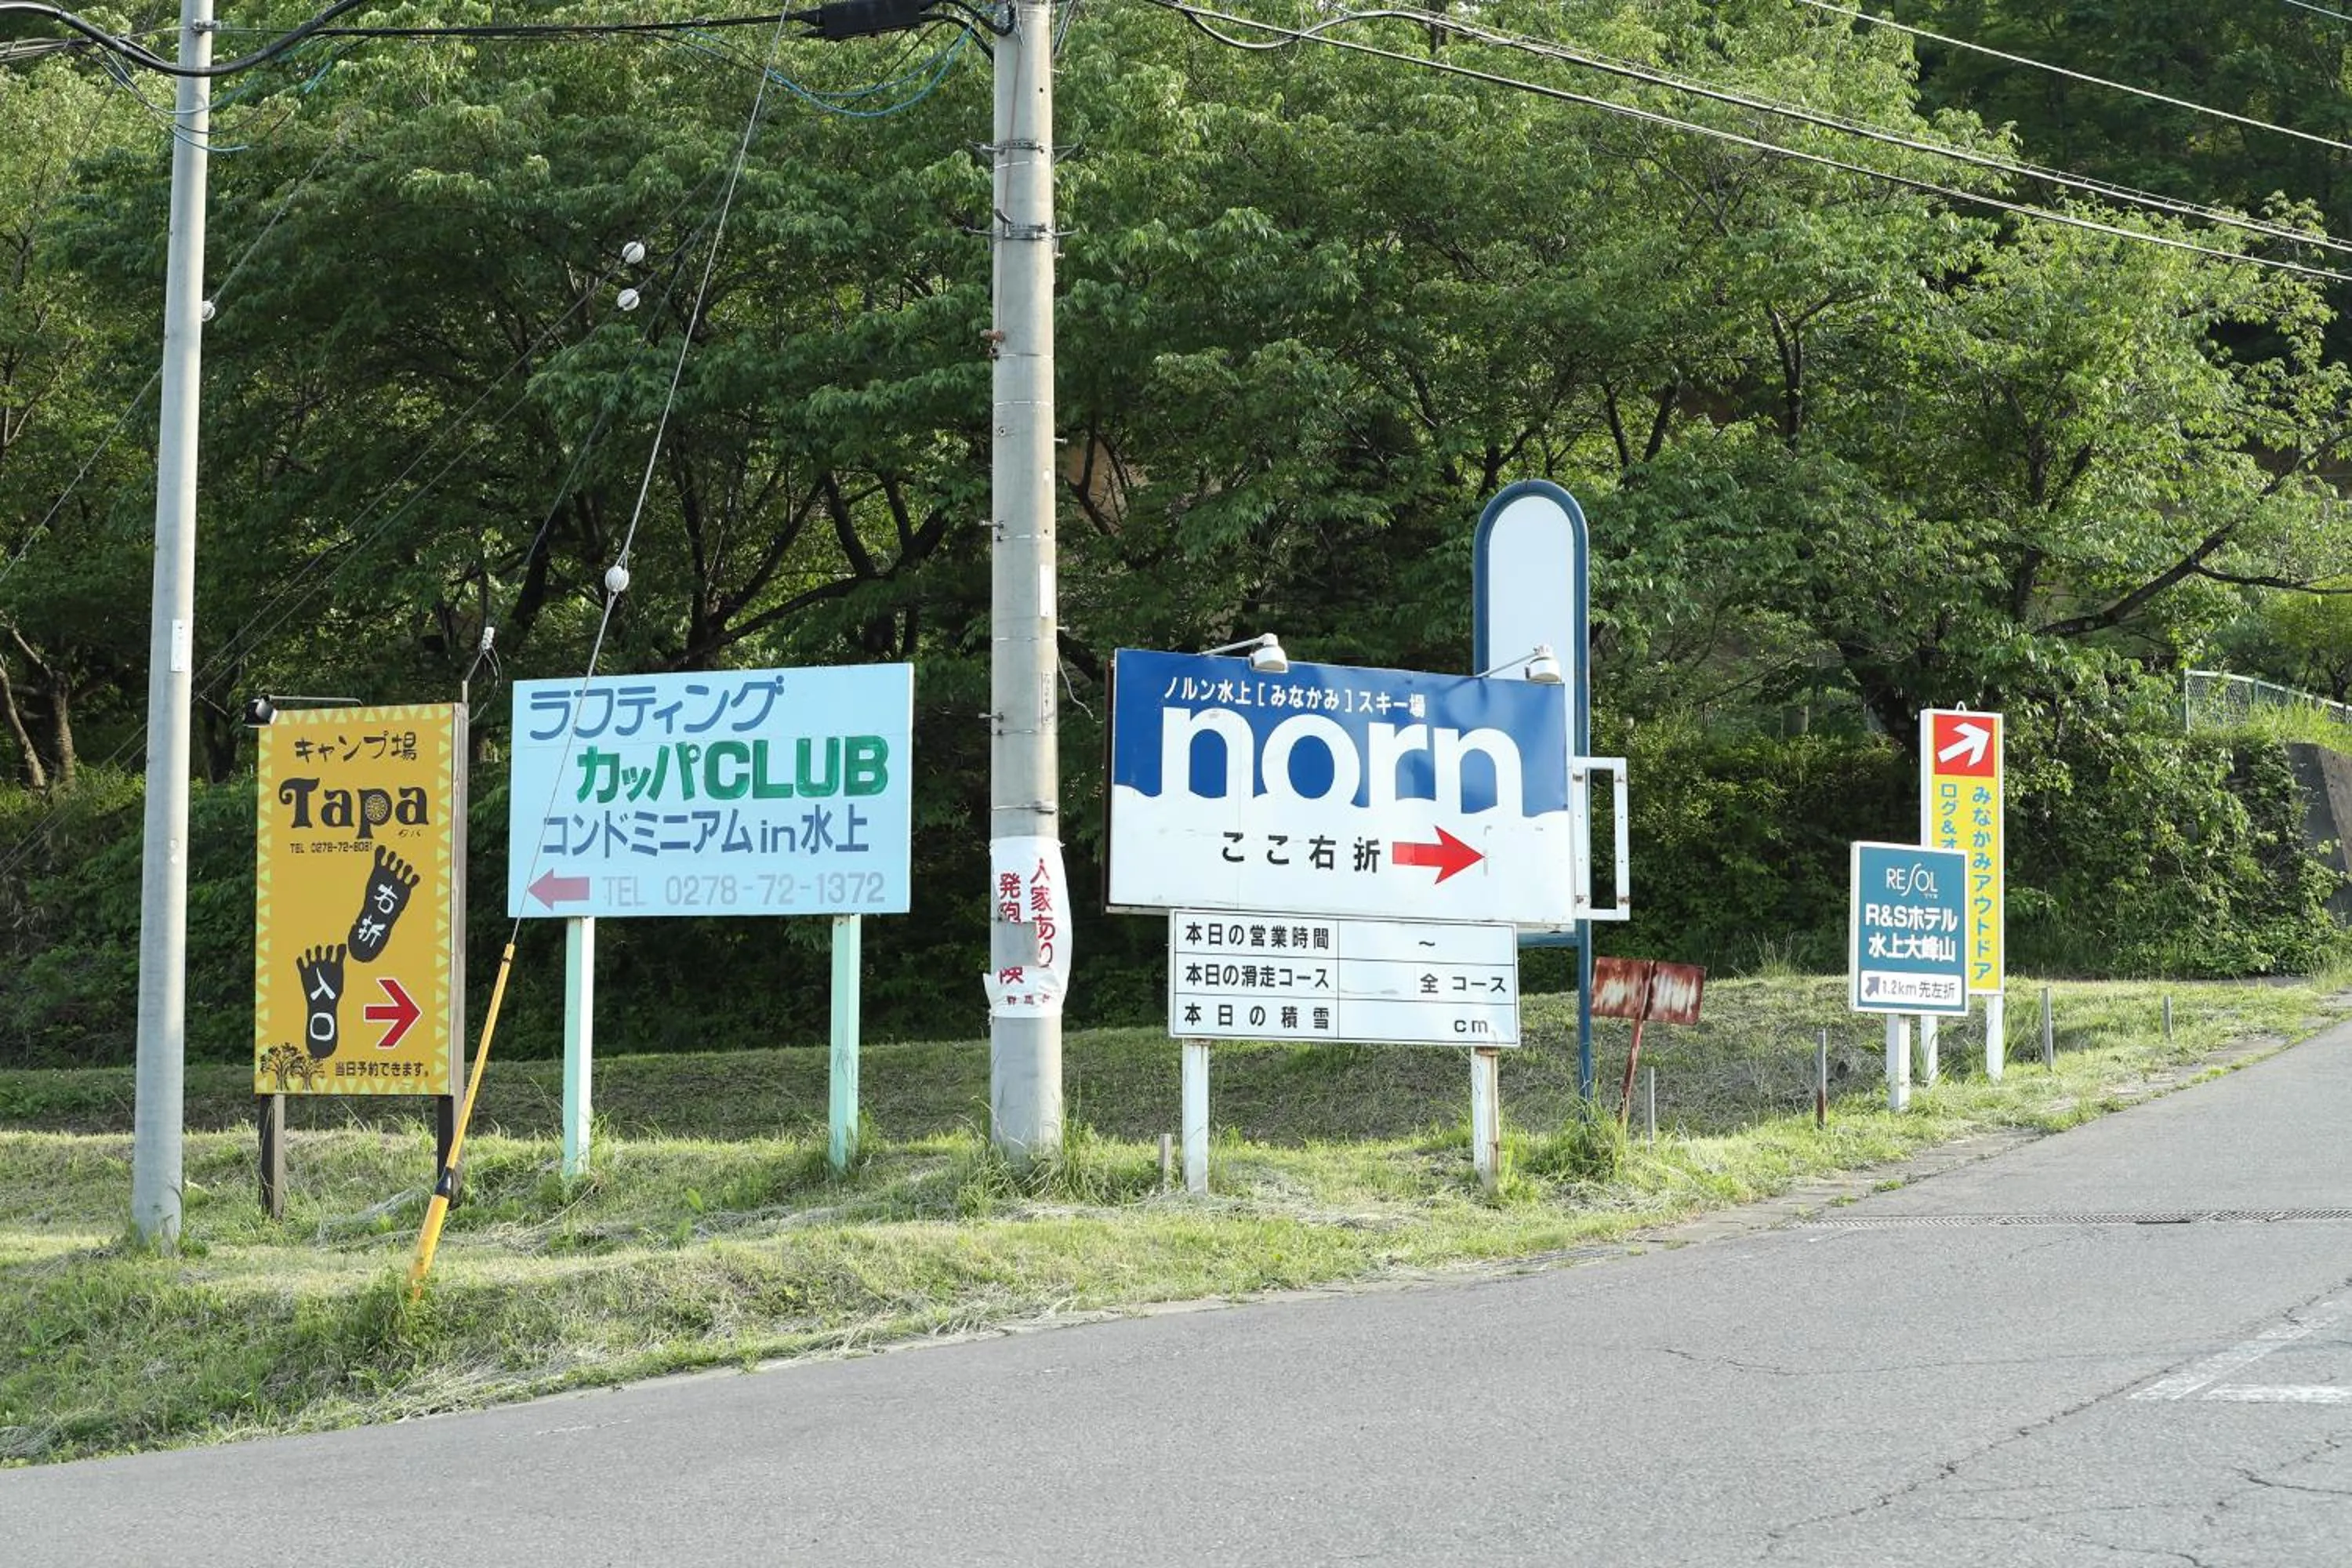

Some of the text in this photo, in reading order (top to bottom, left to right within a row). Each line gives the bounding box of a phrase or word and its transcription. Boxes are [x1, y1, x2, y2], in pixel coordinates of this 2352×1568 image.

[529, 675, 784, 740] ラフティング
[294, 731, 417, 762] キャンプ場
[1162, 706, 1523, 817] norn
[577, 735, 889, 803] カッパCLUB
[278, 777, 429, 840] Tapa
[290, 843, 304, 853] TEL
[542, 804, 870, 858] コンドミニアムin水上
[1221, 831, 1381, 874] ここ右折
[602, 872, 886, 906] TEL 0278-72-1372
[1886, 862, 1938, 897] RESOL
[1973, 786, 1992, 980] みなかみアウトドア
[358, 884, 399, 948] 右折
[1030, 858, 1056, 967] 人家あり
[1865, 903, 1958, 932] R&Sホテル
[1185, 921, 1330, 950] 本日の営業時間
[1868, 932, 1957, 963] 水上大峰山
[1185, 963, 1330, 989] 本日の滑走コース
[310, 967, 336, 1041] 入口
[1184, 1003, 1489, 1033] 本日の積雪 cm
